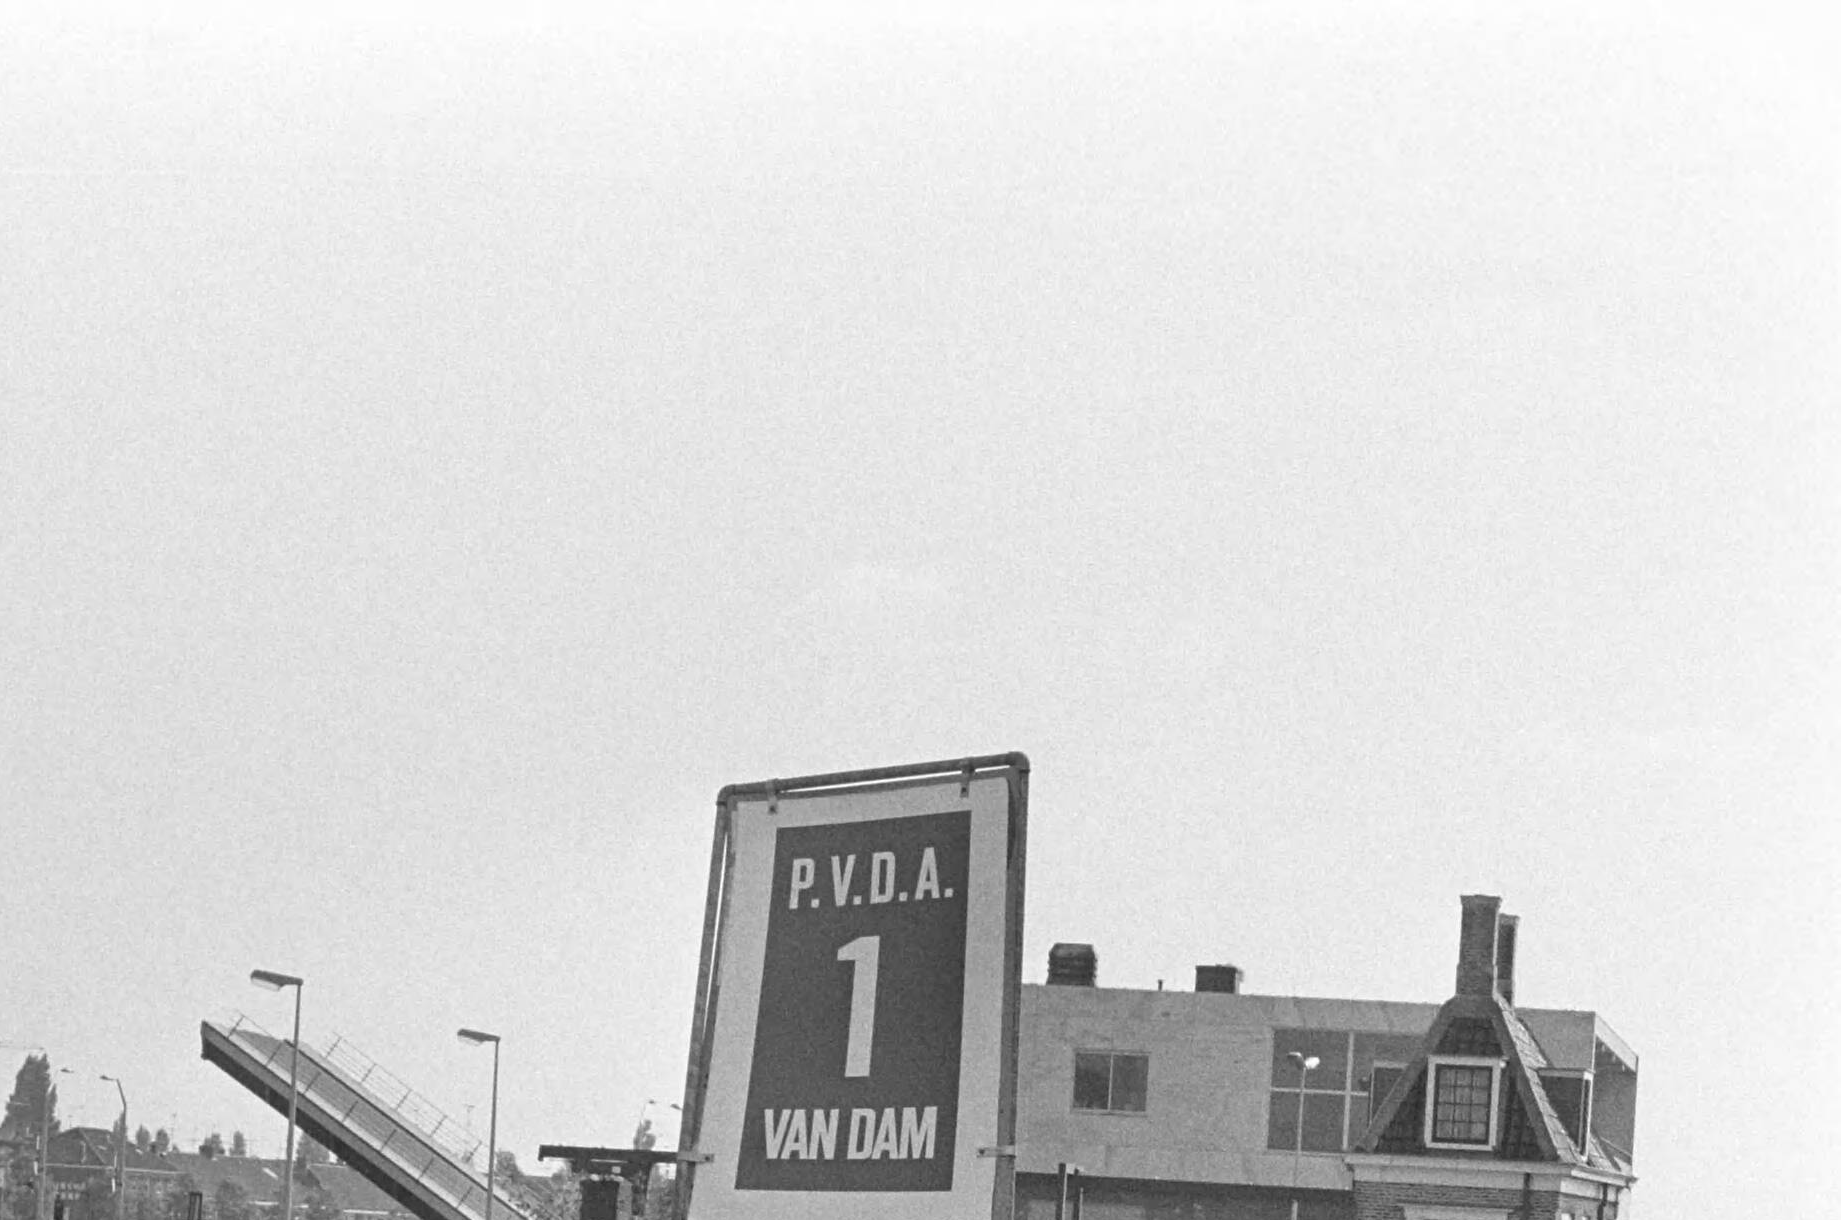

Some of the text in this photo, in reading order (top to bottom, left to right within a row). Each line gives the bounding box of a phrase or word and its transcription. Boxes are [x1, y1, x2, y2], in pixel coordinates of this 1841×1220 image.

[788, 846, 954, 910] P.V.D.A.
[836, 935, 881, 1078] 1
[764, 1105, 938, 1160] VAN DAM
